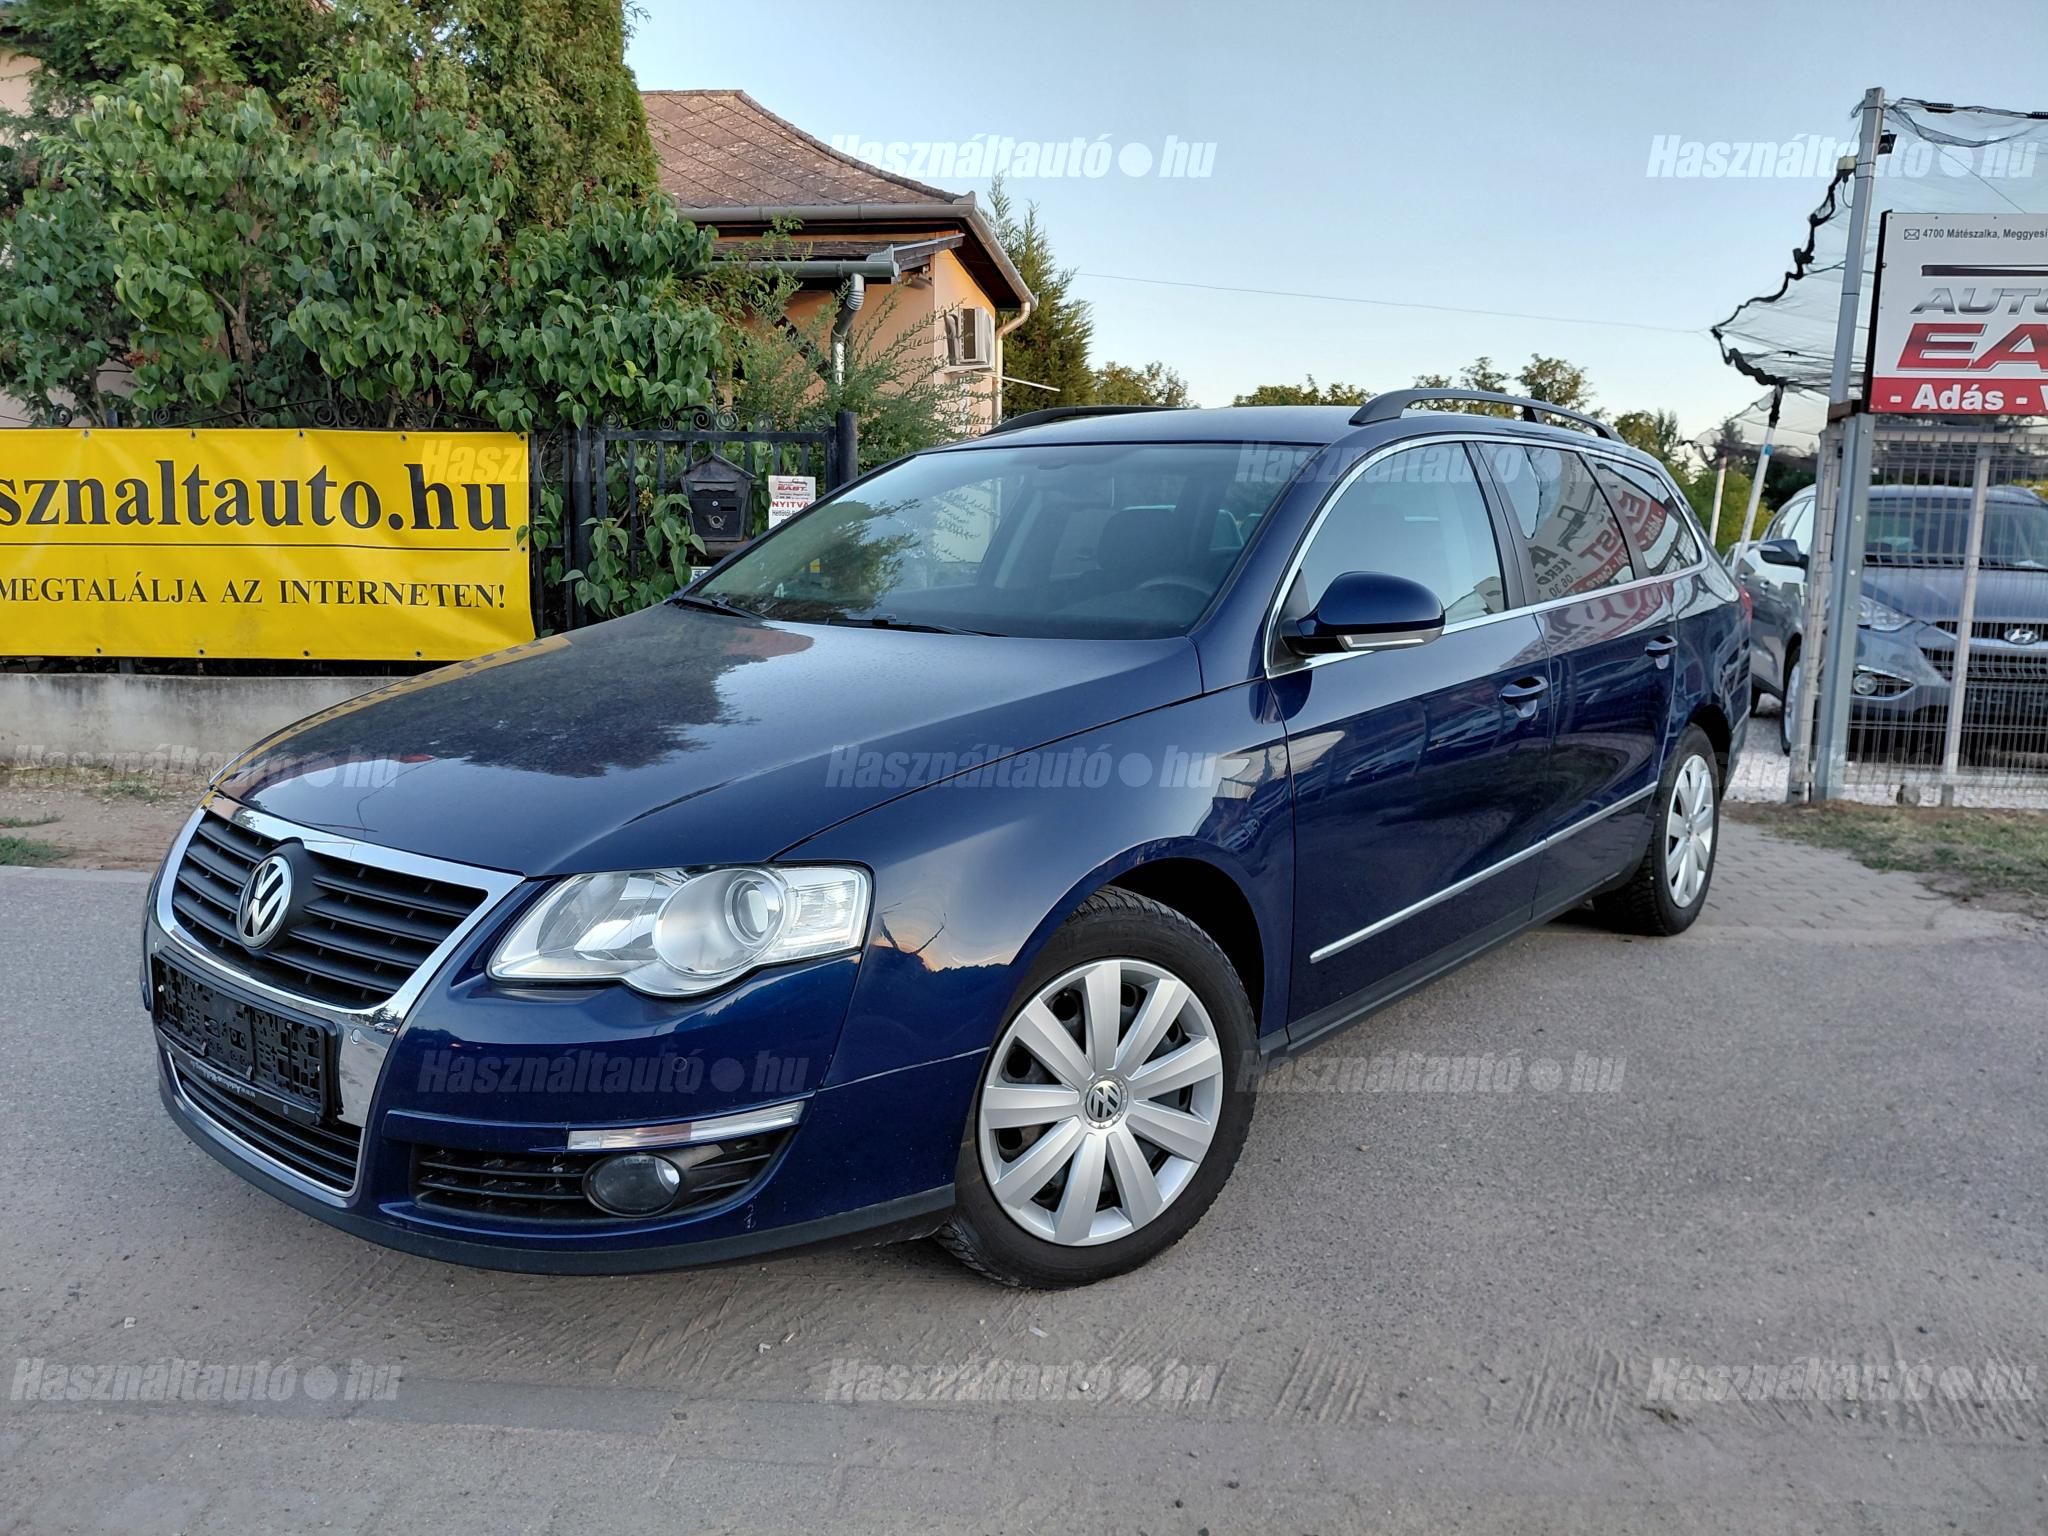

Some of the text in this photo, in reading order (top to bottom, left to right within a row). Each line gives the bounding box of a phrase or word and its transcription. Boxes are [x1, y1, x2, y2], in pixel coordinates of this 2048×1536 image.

[1922, 228, 2048, 241] 4700 Mátészalka, Meggyesi
[1911, 383, 2004, 410] Adás
[0, 460, 512, 530] sznaltauto.hu
[0, 570, 506, 609] MEGTALÁLJA AZ INTERNETEN!
